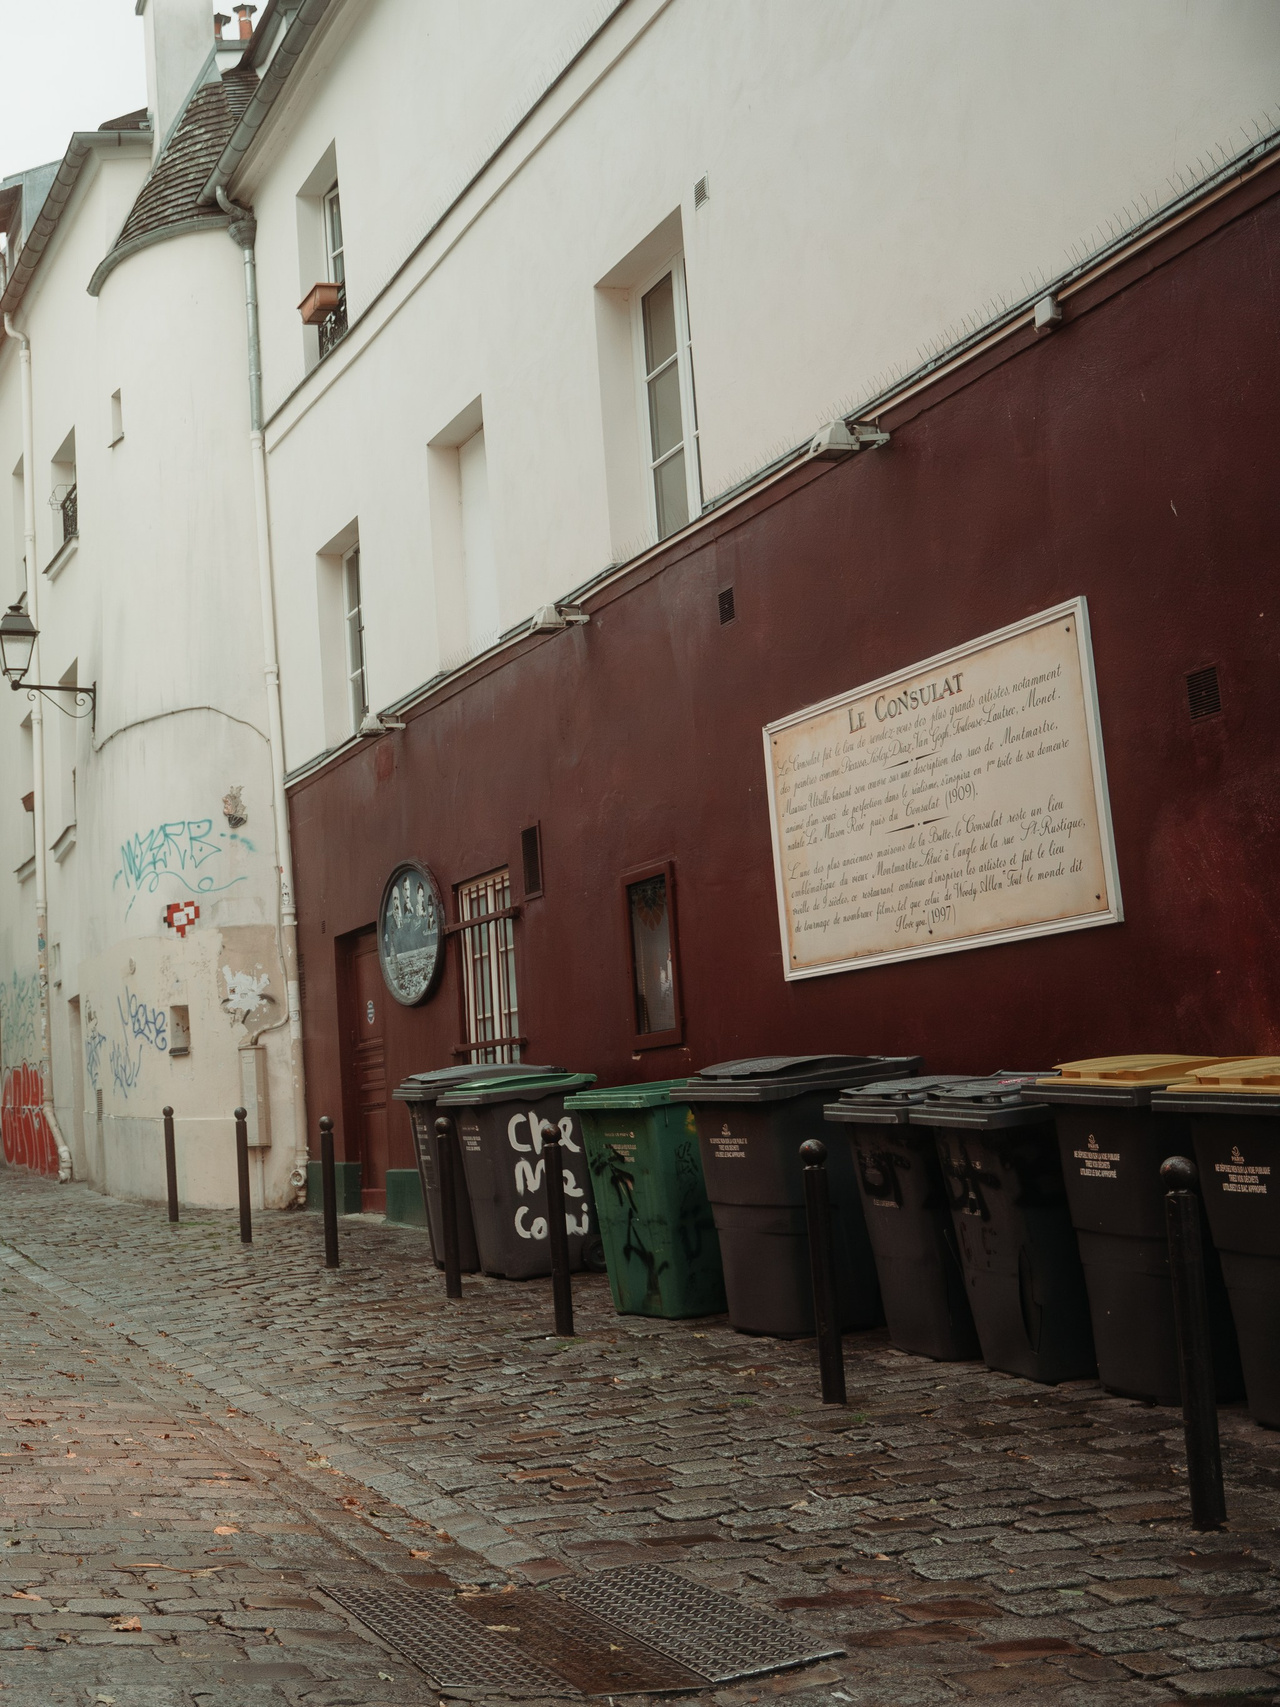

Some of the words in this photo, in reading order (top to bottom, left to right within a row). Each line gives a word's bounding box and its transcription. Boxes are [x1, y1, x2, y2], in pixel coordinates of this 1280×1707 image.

[776, 759, 789, 778] Le
[788, 750, 820, 772] Consulat
[821, 746, 832, 762] fut
[833, 741, 840, 756] le
[841, 739, 854, 754] lieu
[856, 738, 866, 749] de
[913, 713, 926, 729] des
[929, 705, 947, 730] plus
[948, 693, 975, 723] grands
[1011, 662, 1061, 693] notamment
[846, 707, 866, 734] LE
[873, 672, 964, 722] CONSULAT
[779, 781, 791, 795] des
[792, 775, 817, 797] peintres
[818, 767, 840, 782] comme
[912, 728, 928, 748] Van
[781, 797, 808, 818] Maurice
[807, 789, 831, 808] Utrillo
[831, 784, 852, 801] basant
[853, 784, 865, 795] son
[888, 772, 899, 783] sur
[899, 768, 911, 779] une
[912, 756, 948, 776] description
[950, 748, 963, 763] des
[966, 745, 981, 757] rues
[983, 736, 994, 752] de
[784, 818, 804, 834] animé
[805, 812, 819, 828] d'un
[820, 812, 836, 823] souci
[841, 803, 849, 817] de
[850, 797, 882, 823] perfection
[883, 790, 899, 804] dans
[901, 783, 908, 798] le
[972, 766, 982, 776] en
[996, 751, 1012, 768] toile
[1014, 749, 1023, 762] de
[1025, 749, 1034, 760] sa
[1036, 738, 1069, 756] demeure
[786, 835, 805, 851] natale
[819, 822, 845, 842] Maison
[868, 816, 885, 836] puis
[887, 807, 898, 822] du
[902, 795, 939, 817] Consulat
[812, 860, 824, 874] des
[825, 856, 840, 880] plus
[841, 851, 873, 867] anciennes
[876, 843, 906, 858] maisons
[907, 835, 916, 850] de
[917, 831, 925, 847] la
[954, 820, 962, 837] le
[961, 809, 1003, 834] Consulat
[1008, 807, 1026, 823] reste
[1029, 806, 1042, 817] un
[1046, 793, 1063, 813] lieu
[790, 873, 835, 899] emblématique
[839, 871, 848, 886] du
[851, 872, 868, 883] vieux
[918, 846, 941, 867] Situé
[943, 848, 949, 861] à
[951, 837, 977, 862] l'angle
[978, 835, 988, 852] de
[988, 832, 998, 849] la
[1002, 834, 1015, 845] rue
[791, 899, 810, 915] vieille
[812, 897, 820, 911] de
[822, 894, 827, 909] 9
[850, 893, 857, 902] ce
[861, 882, 894, 899] restaurant
[897, 878, 925, 892] continue
[965, 859, 976, 875] les
[977, 856, 1007, 873] artistes
[1008, 852, 1017, 866] et
[1020, 848, 1033, 870] fut
[1036, 842, 1045, 859] le
[1047, 838, 1064, 856] lieu
[794, 919, 802, 933] de
[803, 918, 830, 933] tournage
[832, 911, 840, 925] de
[842, 906, 873, 922] nombreux
[896, 895, 908, 912] tel
[909, 899, 921, 915] que
[923, 889, 940, 906] celui
[943, 887, 952, 901] de
[952, 879, 978, 902] Woody
[978, 873, 1003, 894] Allen
[1025, 866, 1034, 883] le
[1036, 861, 1065, 880] monde
[1068, 857, 1082, 873] dit
[899, 911, 914, 930] love
[927, 903, 956, 931] (1997)
